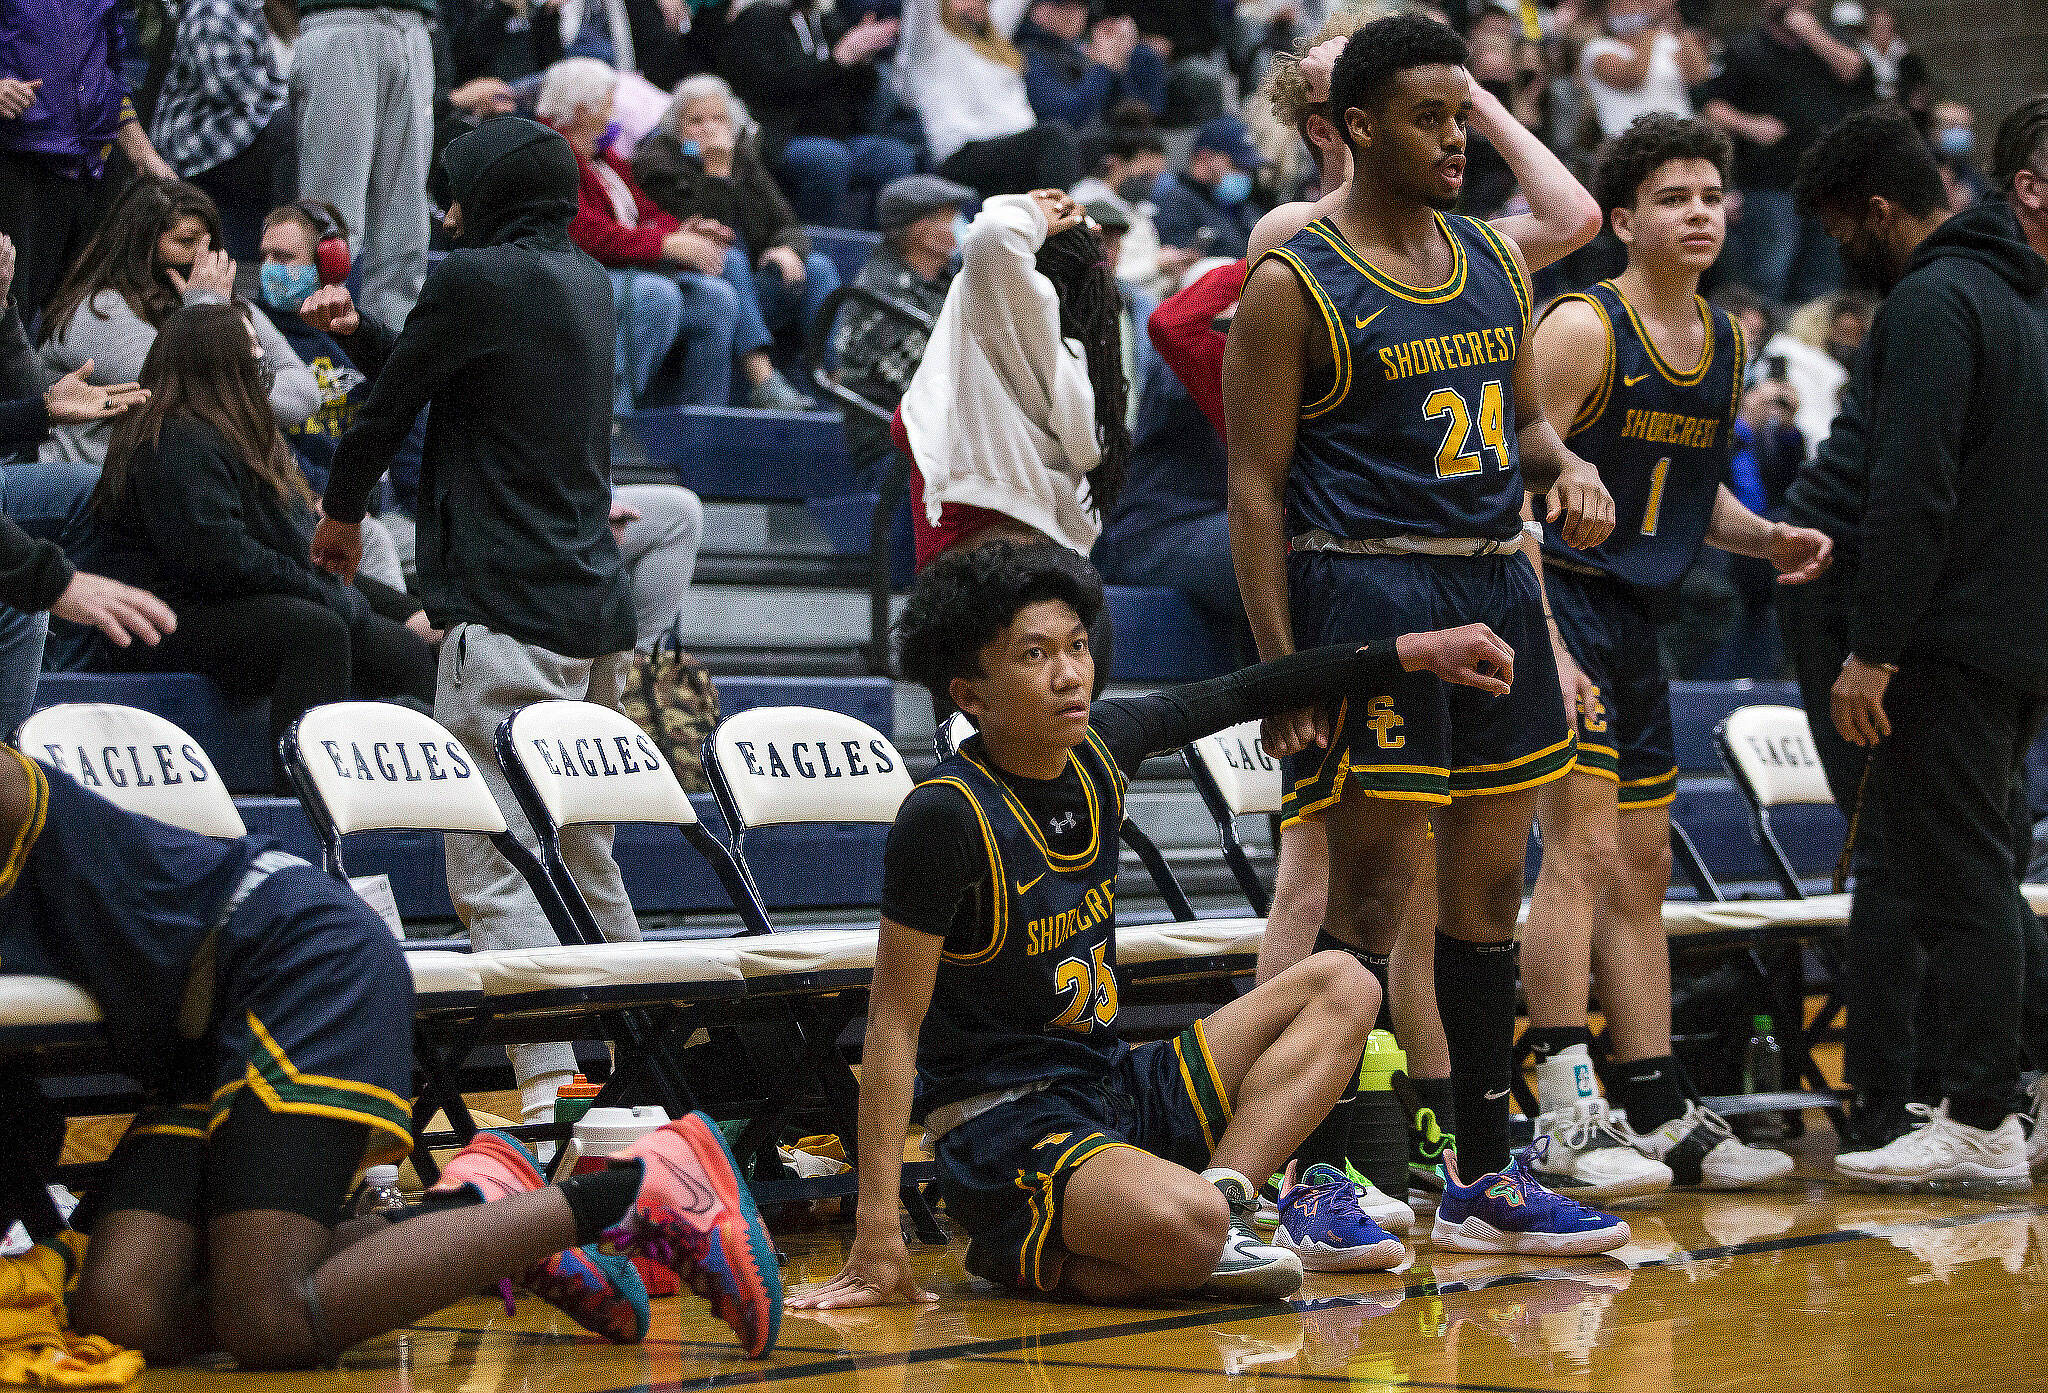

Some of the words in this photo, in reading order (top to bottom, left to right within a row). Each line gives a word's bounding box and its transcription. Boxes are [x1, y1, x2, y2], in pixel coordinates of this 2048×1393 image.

[1379, 327, 1516, 380] SHORECREST
[1422, 380, 1510, 479] 24
[1640, 457, 1671, 536] 1
[43, 743, 208, 788] EAGLES
[321, 740, 471, 781] EAGLES
[532, 735, 660, 777] EAGLES
[735, 739, 894, 779] EAGLES
[1044, 937, 1119, 1035] 25
